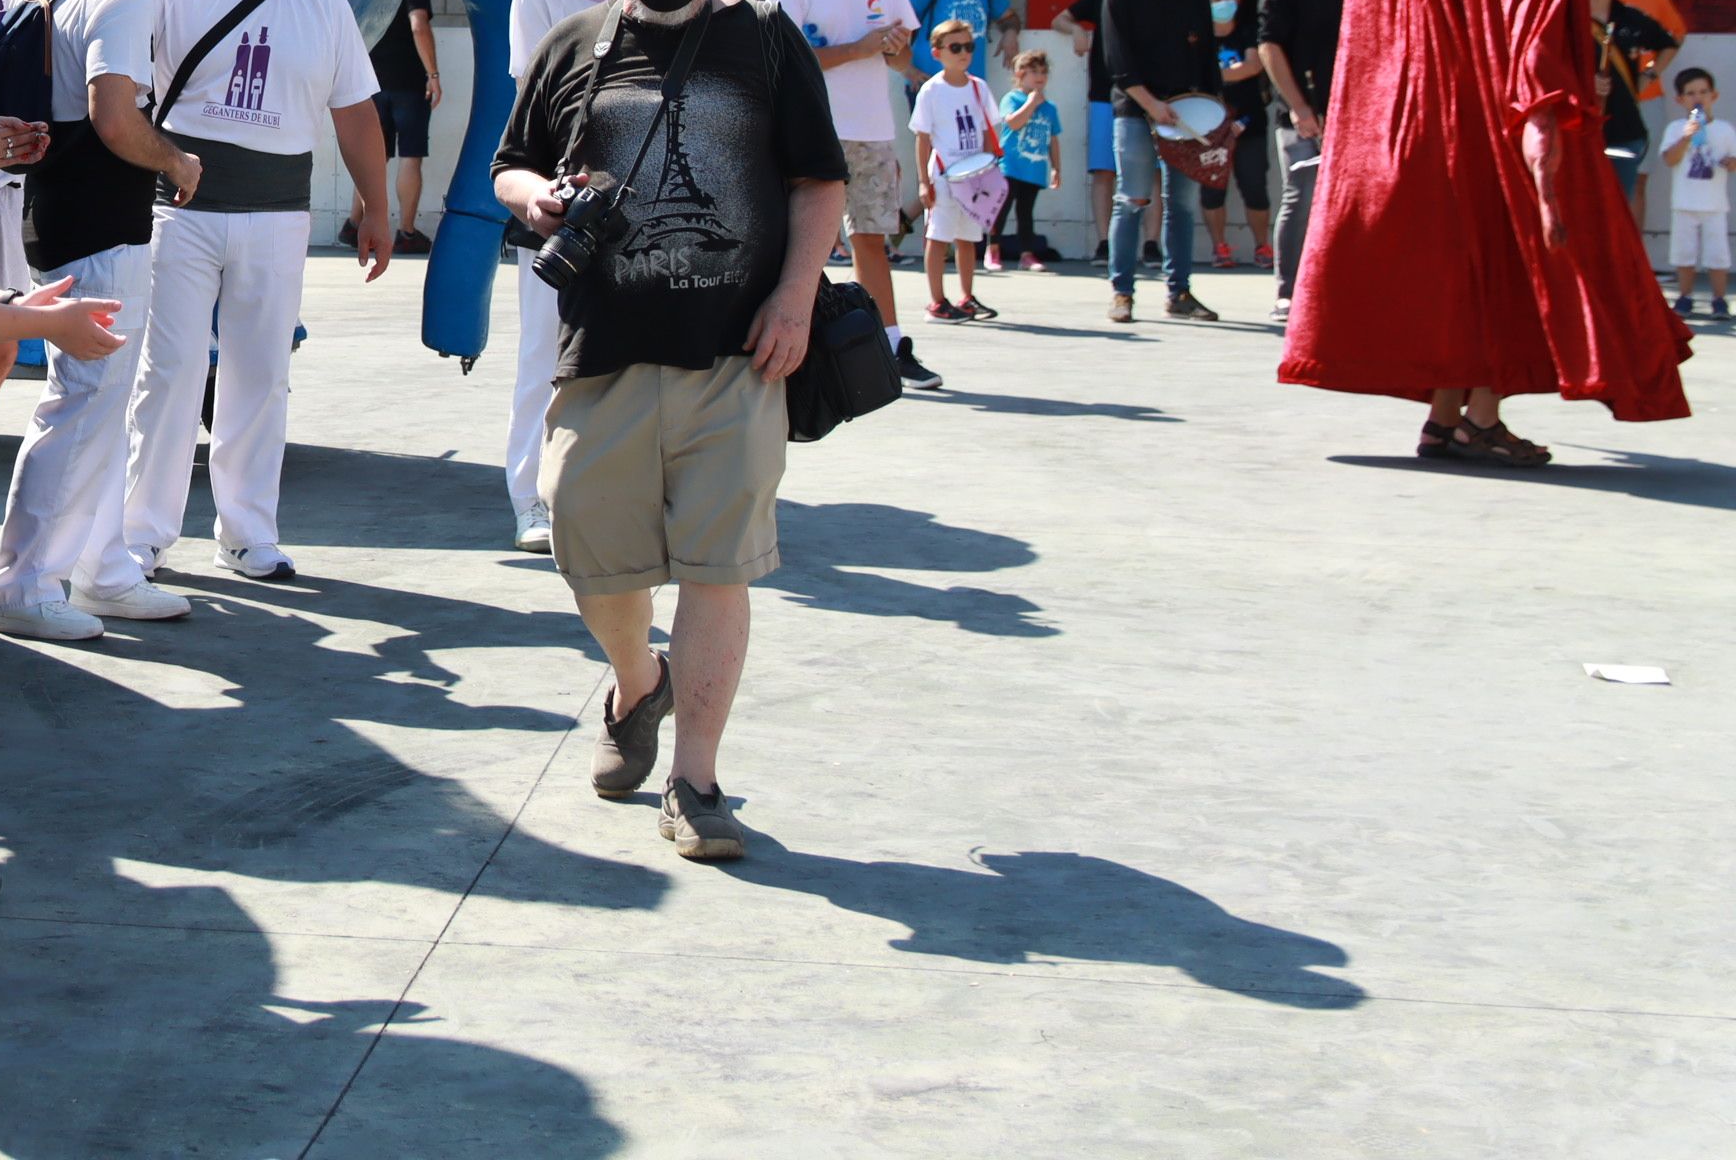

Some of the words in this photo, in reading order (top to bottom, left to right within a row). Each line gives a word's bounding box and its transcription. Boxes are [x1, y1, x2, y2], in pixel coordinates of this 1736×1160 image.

[202, 104, 250, 121] GEGANTERS
[251, 112, 263, 123] DE
[613, 245, 693, 285] PARIS
[669, 277, 689, 289] La
[691, 274, 722, 289] Tour
